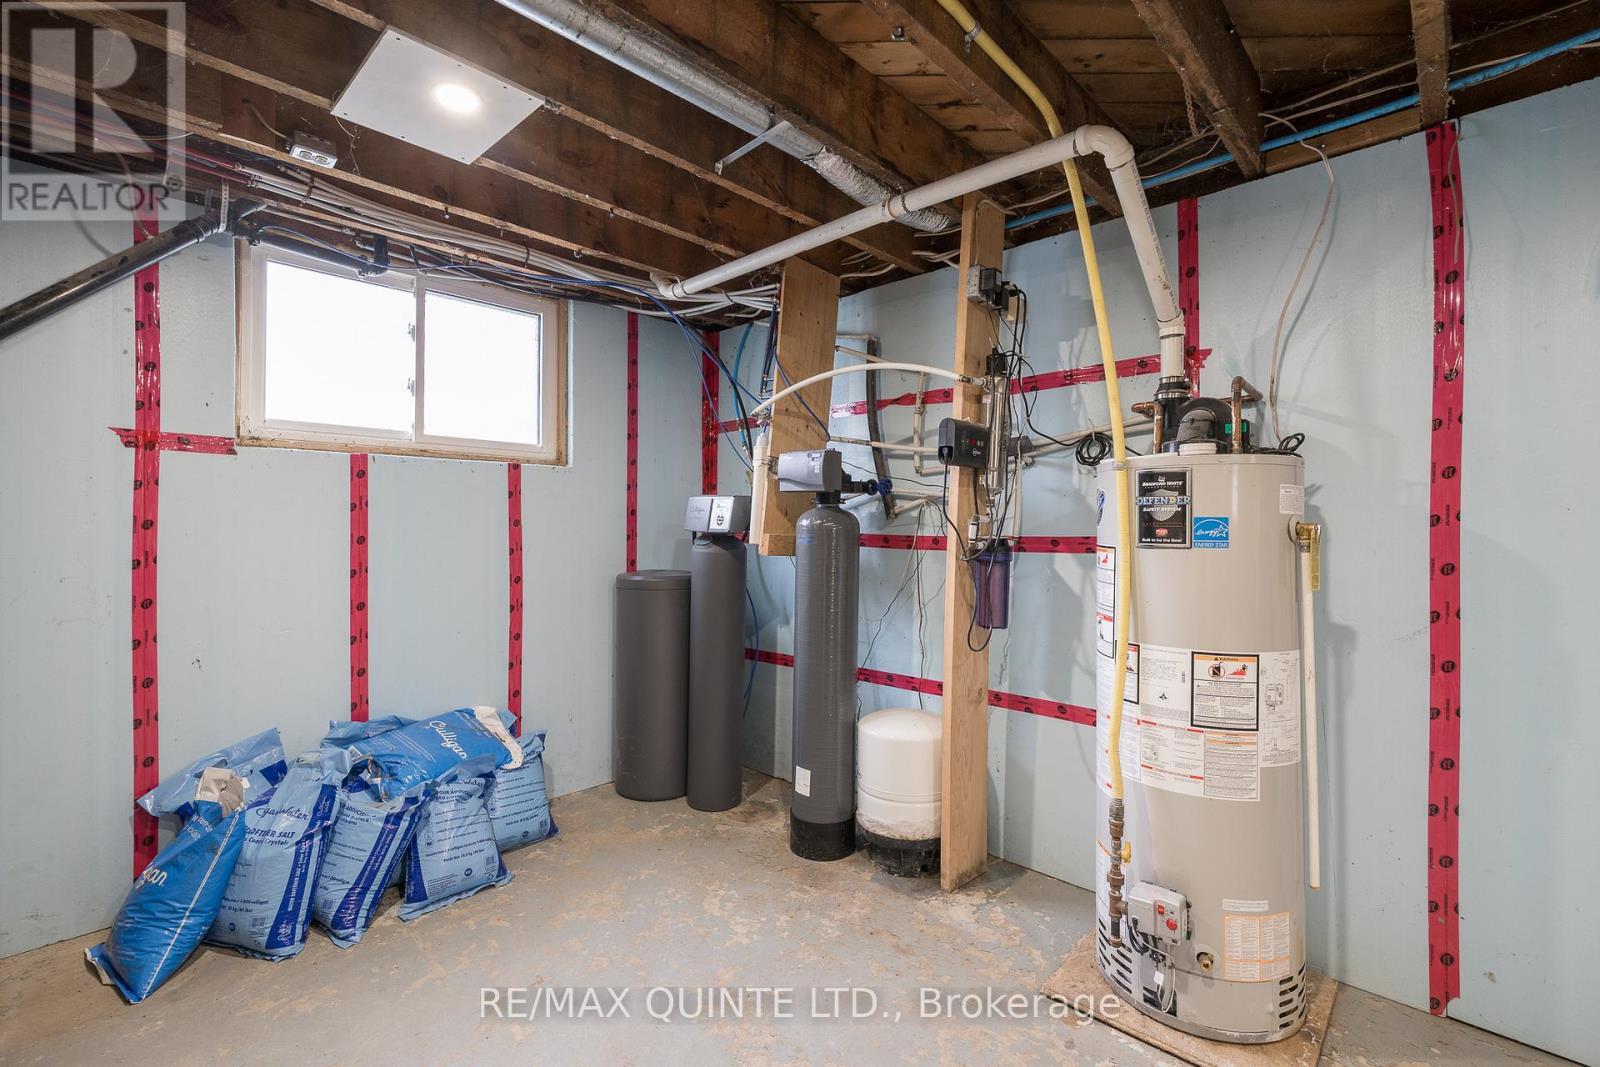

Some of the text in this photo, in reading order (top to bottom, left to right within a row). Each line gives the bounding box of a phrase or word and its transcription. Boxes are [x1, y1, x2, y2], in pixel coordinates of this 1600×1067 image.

[1136, 496, 1191, 505] DEFENDER
[429, 720, 468, 761] Culligan
[277, 831, 296, 839] SALT
